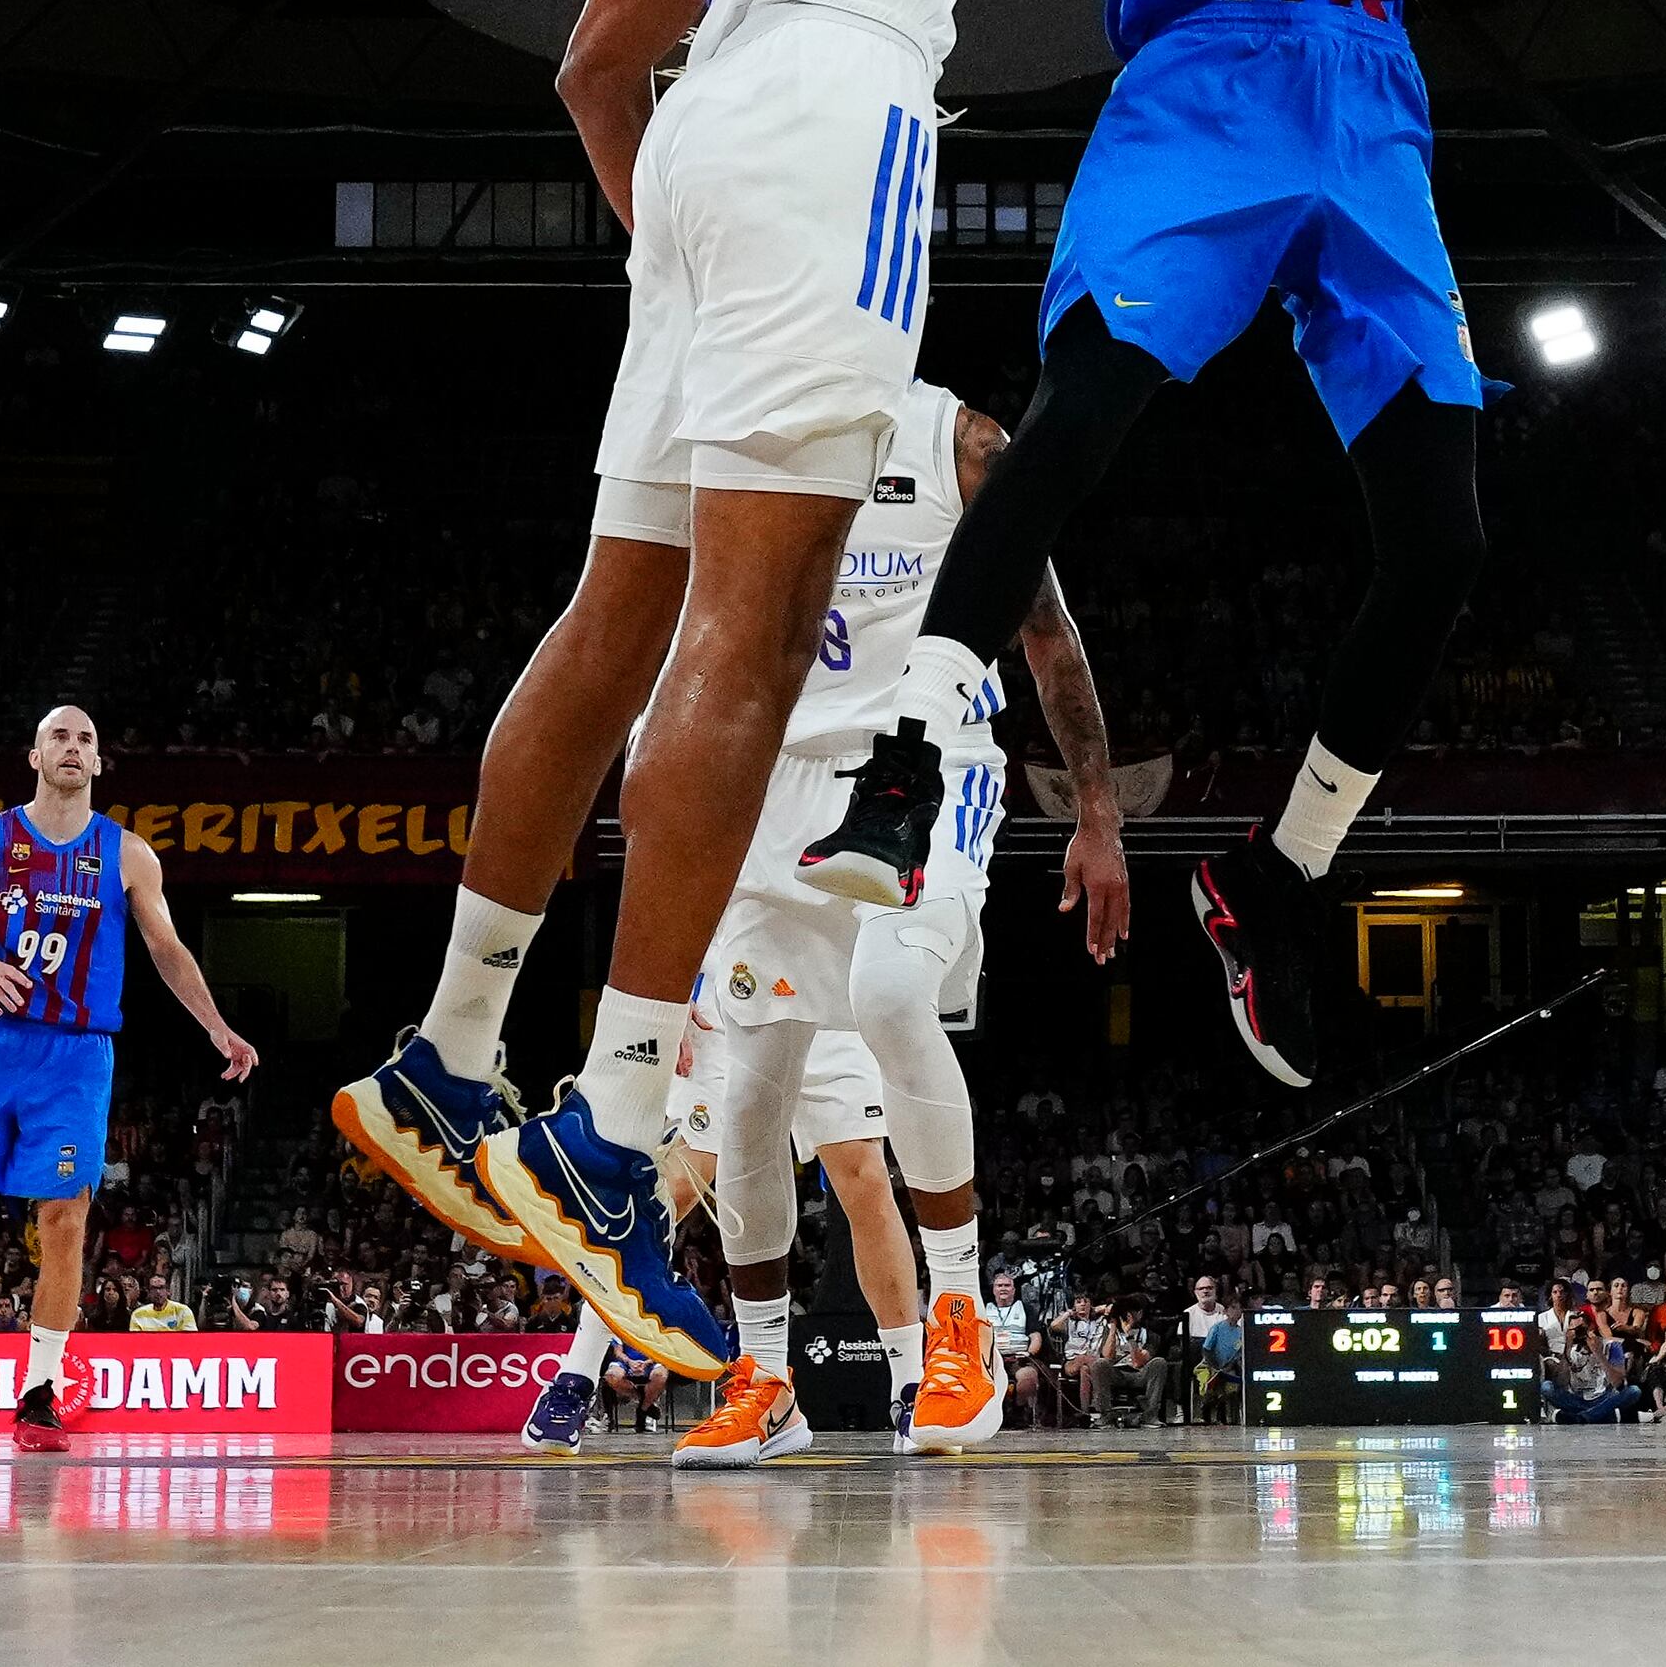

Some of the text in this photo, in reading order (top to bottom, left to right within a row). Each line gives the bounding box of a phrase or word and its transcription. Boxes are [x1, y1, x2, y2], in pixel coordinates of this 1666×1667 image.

[839, 551, 923, 578] DIUM
[841, 580, 920, 599] GROUP
[34, 902, 81, 918] Sanitària
[35, 889, 101, 910] Assistència
[17, 930, 68, 975] 99
[614, 1049, 660, 1067] adidas
[1254, 1313, 1295, 1325] LOCAL
[1269, 1327, 1525, 1353] 2 6:02 1 10
[90, 1357, 279, 1410] DAMM
[1266, 1389, 1518, 1411] 2 1
